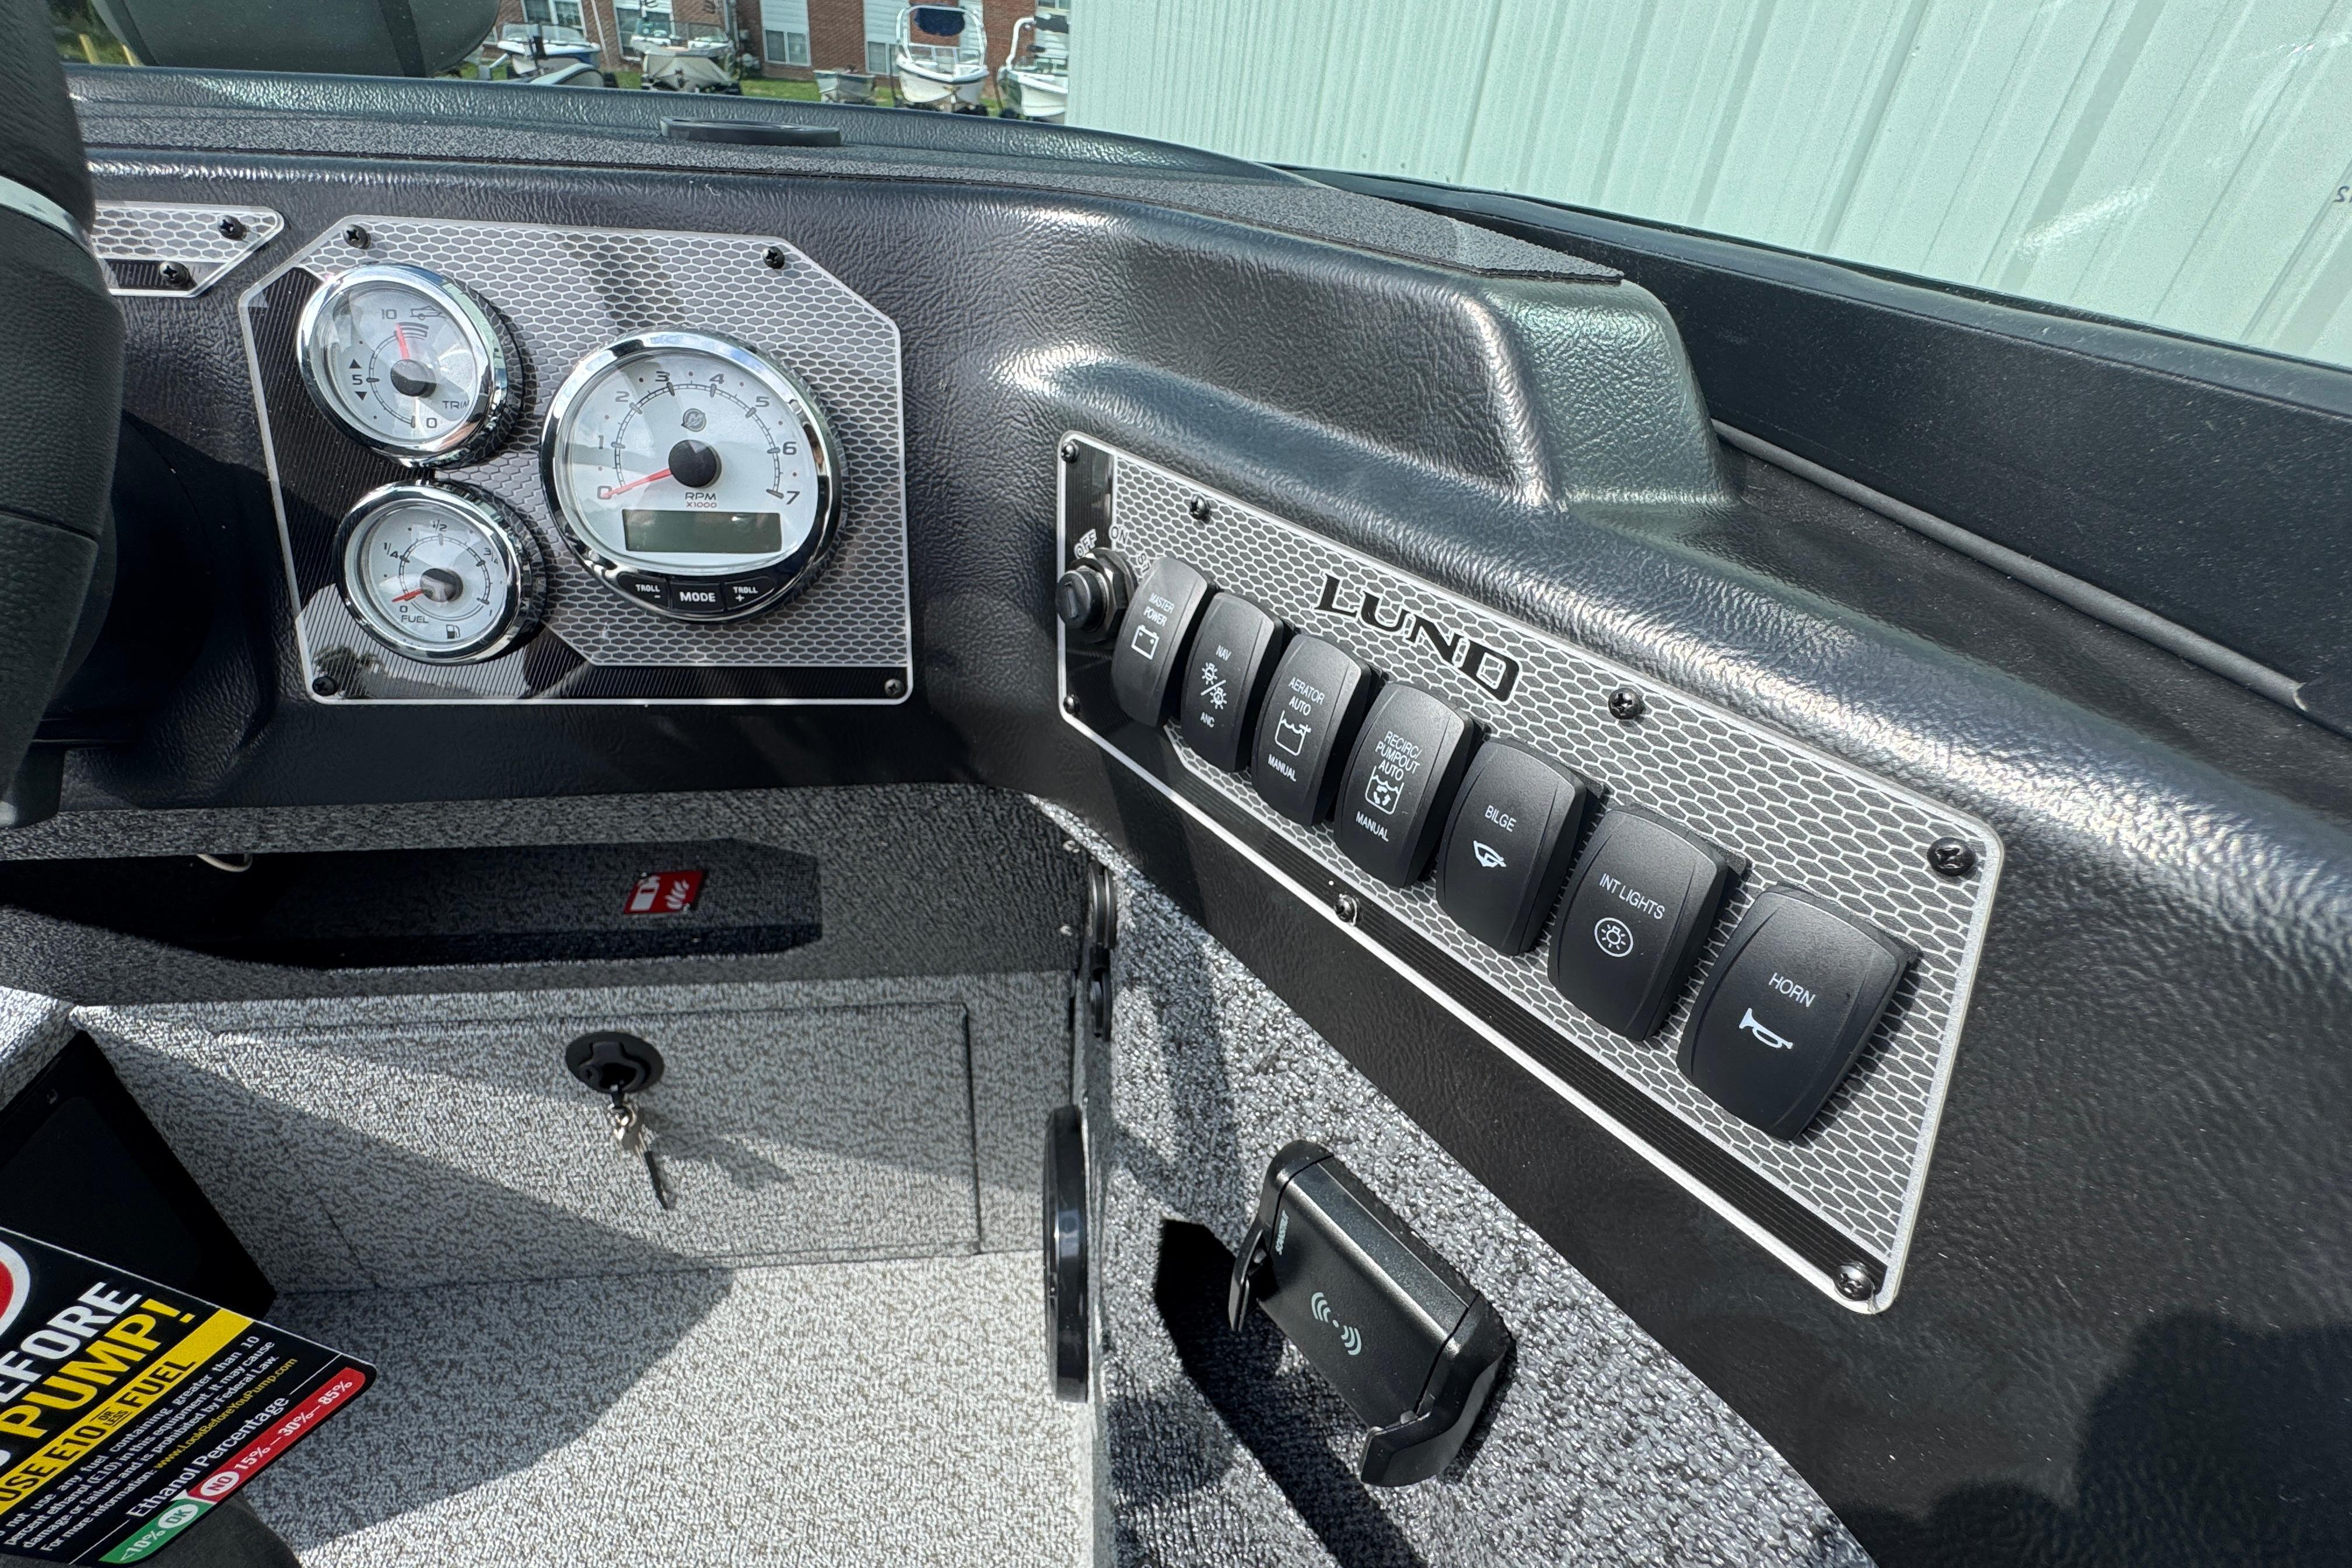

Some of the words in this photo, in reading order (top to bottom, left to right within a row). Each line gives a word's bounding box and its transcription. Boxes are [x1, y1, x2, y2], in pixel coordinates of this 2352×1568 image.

[381, 309, 397, 320] 10
[352, 374, 363, 386] 5
[655, 371, 670, 383] 3
[709, 373, 724, 384] 4
[615, 391, 630, 403] 2
[755, 396, 769, 407] 5
[426, 418, 438, 429] 0
[598, 435, 604, 450] 1
[782, 441, 797, 456] 6
[597, 485, 612, 501] 0
[685, 492, 716, 501] RPM
[785, 491, 800, 505] 7
[1076, 530, 1096, 558] OFF
[1110, 526, 1129, 544] ON
[635, 584, 660, 592] TROLL
[679, 591, 716, 603] MODE
[399, 605, 408, 613] 0
[1149, 592, 1175, 614] MASTER
[401, 614, 429, 624] FUEL
[1143, 606, 1167, 627] POWER
[1314, 572, 1520, 704] LUND
[1215, 644, 1232, 662] NAV
[1287, 676, 1325, 706] AERATOR
[1288, 695, 1311, 716] AUTO
[1200, 712, 1215, 728] ANC
[1384, 730, 1423, 760] RECIRC/
[1375, 740, 1420, 774] PUMPOUT
[1268, 753, 1297, 782] MANUAL
[1378, 758, 1404, 782] AUTO
[1355, 810, 1390, 842] MANUAL
[1484, 804, 1517, 833] BILGE
[1599, 873, 1621, 894] INT
[1618, 884, 1666, 921] LIGHTS
[1768, 972, 1817, 1008] HORN
[0, 1298, 195, 1439] PUMP!
[115, 1360, 197, 1409] FUEL
[97, 1410, 116, 1422] OR
[103, 1409, 129, 1426] LESS
[6, 1513, 32, 1528] not
[30, 1493, 57, 1510] use
[57, 1474, 83, 1492] any
[80, 1455, 110, 1472] fuel
[109, 1408, 174, 1453] containing
[172, 1374, 213, 1406] greater
[211, 1352, 243, 1372] than
[240, 1336, 260, 1349] 10
[4, 1514, 51, 1545] percent
[47, 1483, 92, 1515] ethanol
[87, 1461, 123, 1484] (E10)
[116, 1451, 135, 1462] in
[130, 1436, 156, 1452] this
[152, 1392, 215, 1436] equipment.
[208, 1383, 224, 1391] It
[220, 1365, 246, 1384] may
[242, 1341, 275, 1367] cause
[22, 1513, 73, 1548] damage
[69, 1502, 86, 1515] or
[79, 1478, 121, 1505] failure
[118, 1460, 144, 1479] and
[139, 1453, 154, 1462] is
[150, 1412, 207, 1454] prohibited
[200, 1402, 220, 1413] by
[214, 1372, 256, 1402] Federal
[251, 1356, 280, 1374] Law.
[0, 1463, 59, 1502] USE
[43, 1424, 107, 1462] E10
[40, 1537, 65, 1552] For
[62, 1516, 96, 1538] more
[88, 1468, 158, 1517] information:
[153, 1357, 299, 1469] www.LookBeforeYouPump.com
[125, 1466, 197, 1517] Ethanol
[192, 1396, 290, 1468] Percentage
[207, 1474, 233, 1492] NO
[164, 1508, 192, 1524] OK
